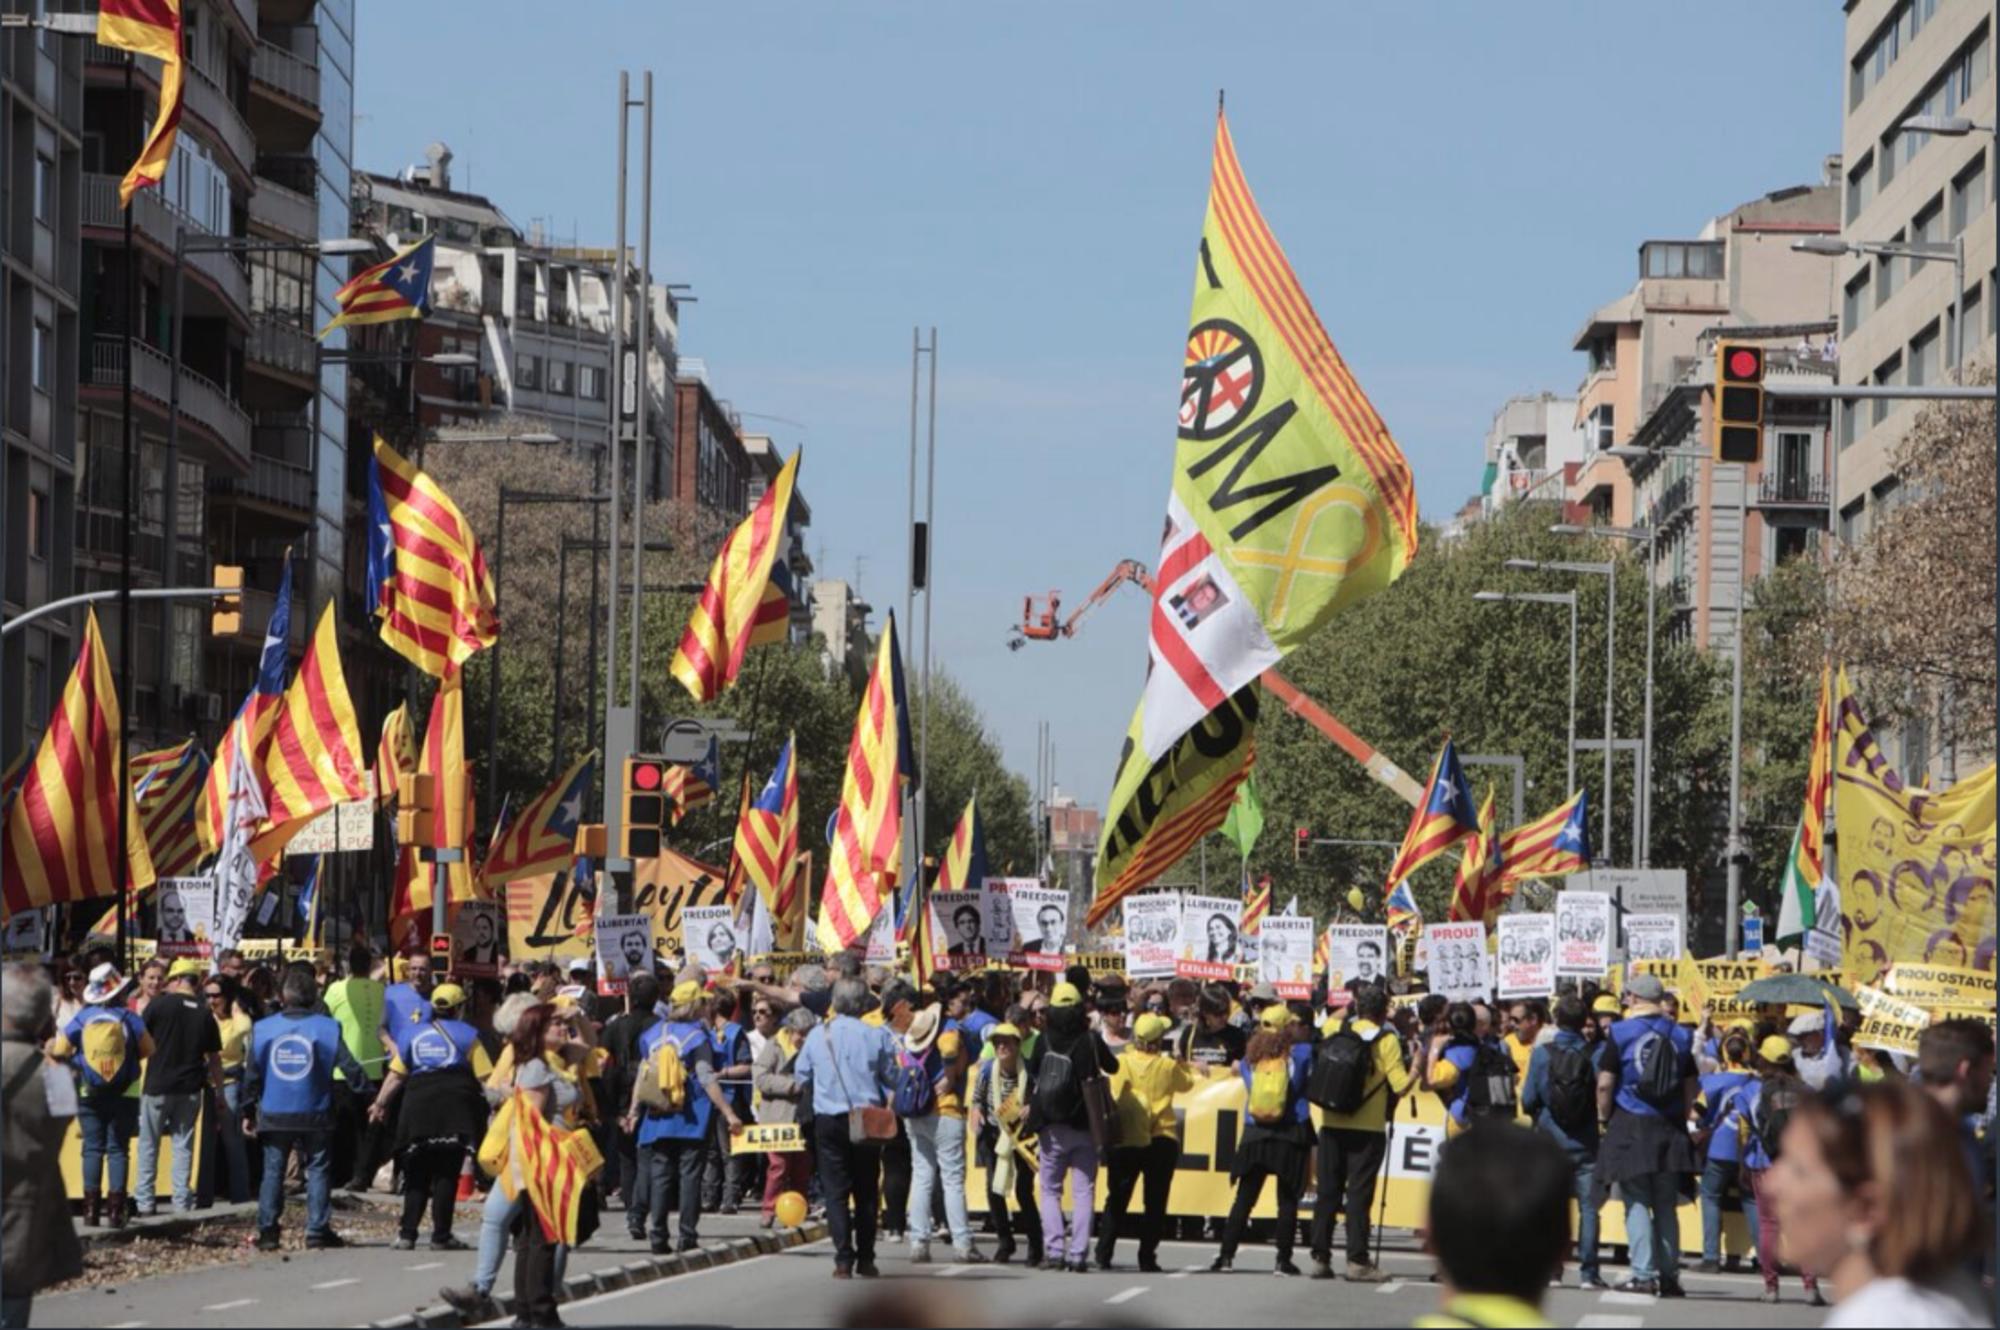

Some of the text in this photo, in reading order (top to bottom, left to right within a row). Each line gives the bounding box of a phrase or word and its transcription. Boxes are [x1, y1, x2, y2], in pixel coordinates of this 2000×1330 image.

[932, 892, 980, 901] FREEDOM
[1016, 890, 1066, 903] FREEDOM
[1187, 899, 1239, 912] LLIBERTAT
[684, 909, 731, 919] FREEDOM
[597, 918, 648, 929] LLIBERTAT
[1262, 920, 1312, 930] LLIBERTAT
[1332, 928, 1384, 938] FREEDOM
[1432, 928, 1479, 940] PROU!
[1650, 963, 1758, 981] LLIRTAT
[1896, 968, 1935, 981] PROU
